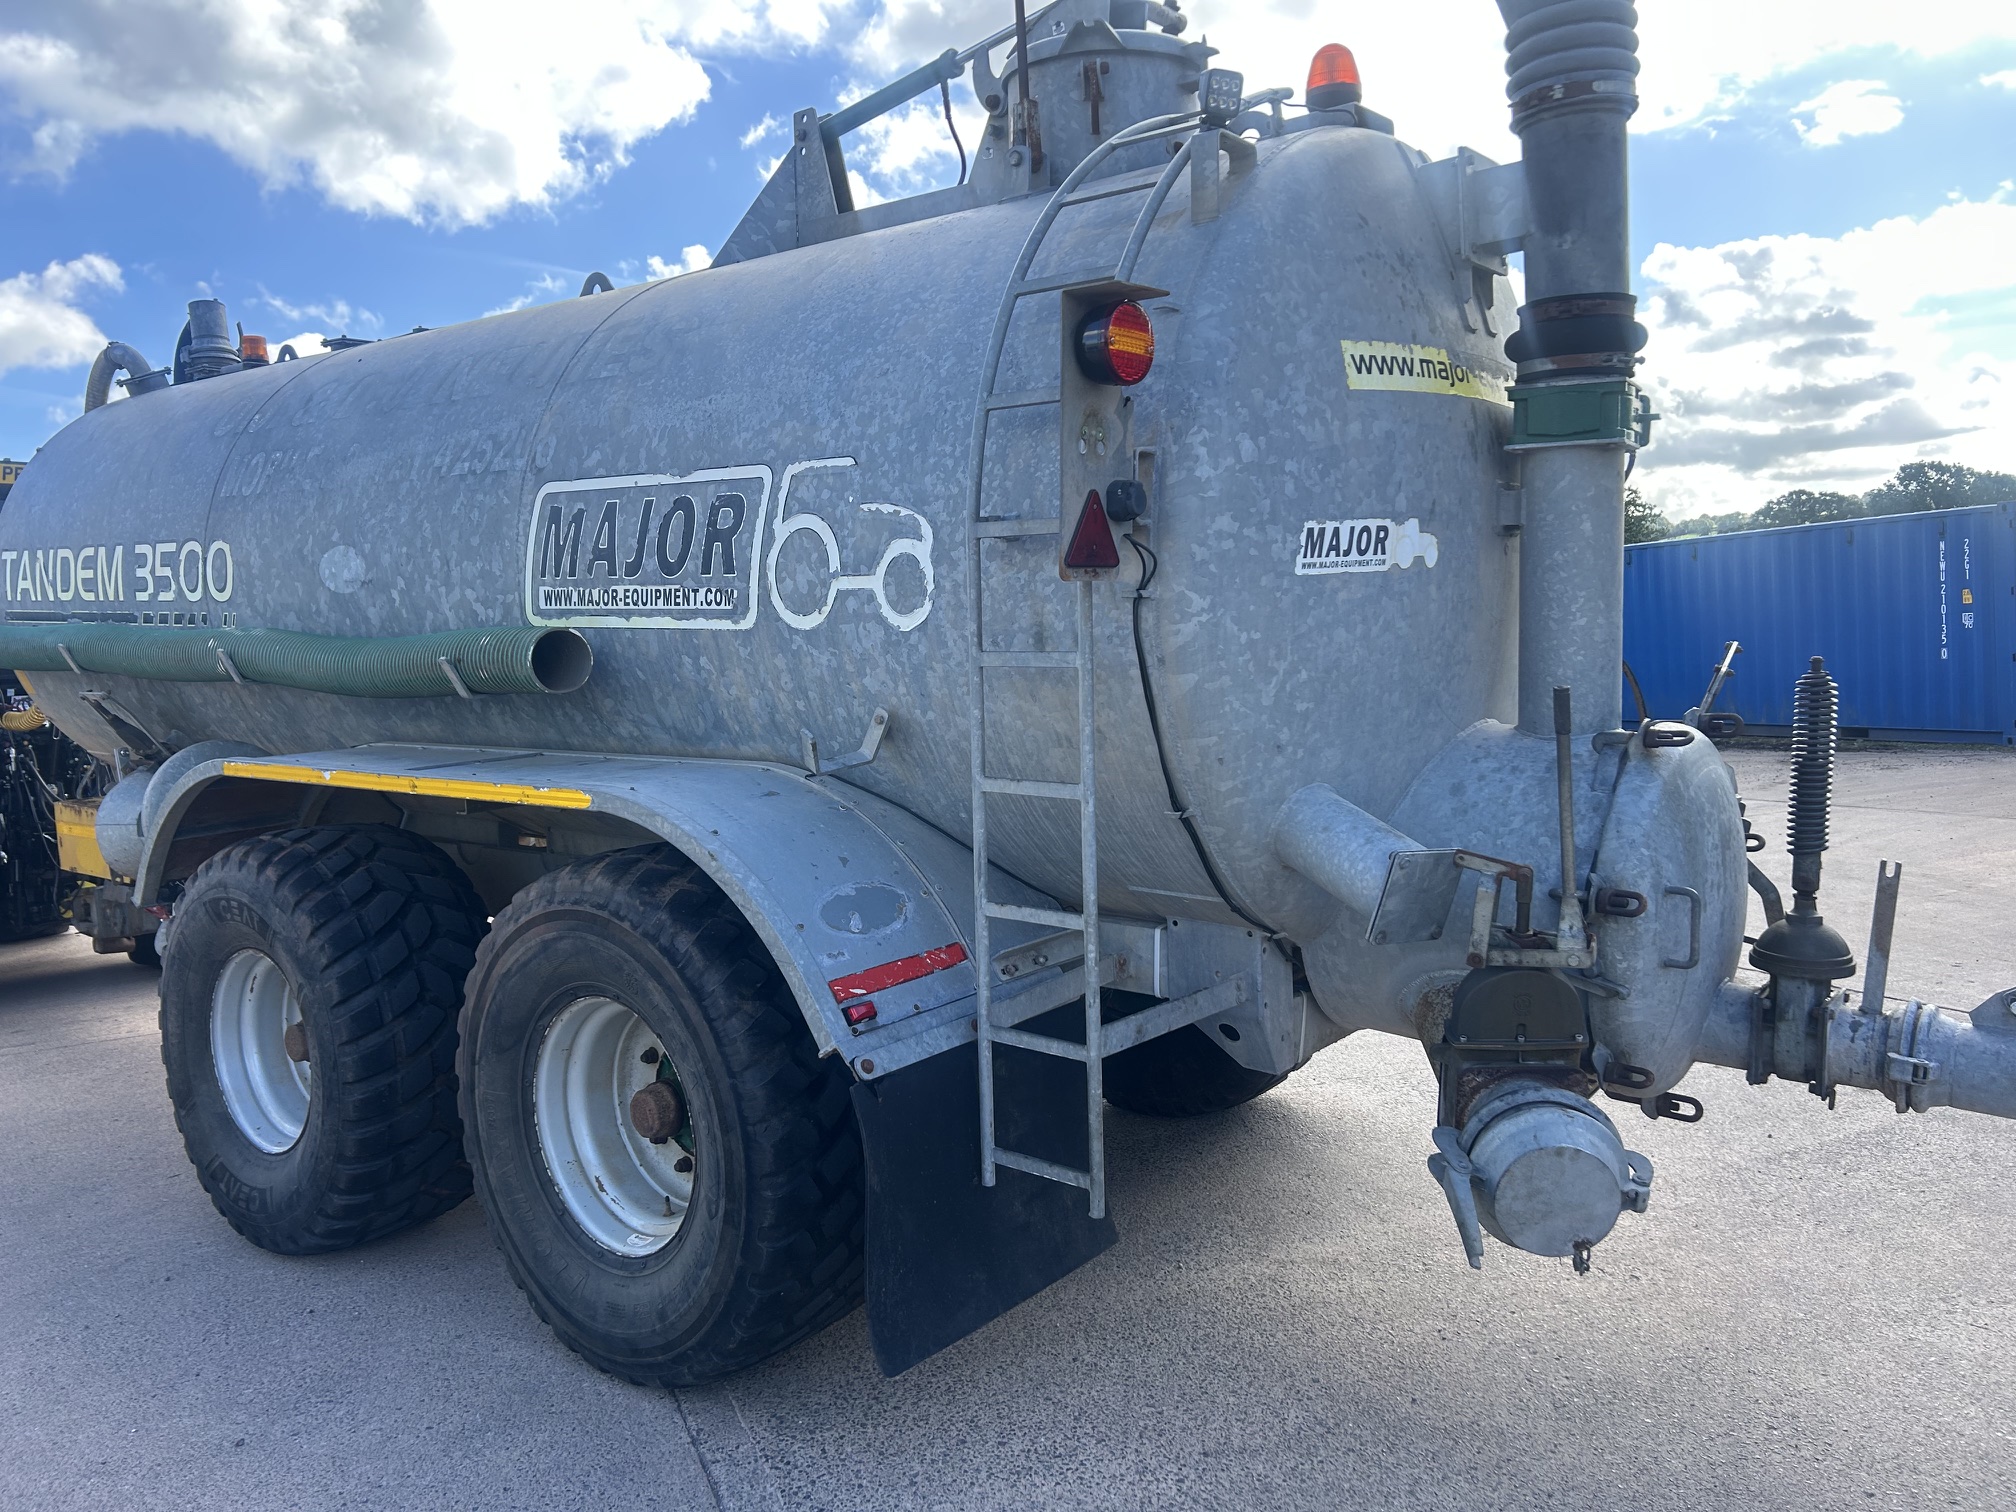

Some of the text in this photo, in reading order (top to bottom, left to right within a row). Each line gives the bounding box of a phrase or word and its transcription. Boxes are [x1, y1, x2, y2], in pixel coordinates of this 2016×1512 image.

[539, 492, 747, 579] MAJOR
[1302, 525, 1389, 559] MAJOR
[1, 540, 233, 602] TANDEM 3500
[1301, 559, 1387, 570] WWW.MAJOR-EQUIPMENT.COM
[543, 586, 736, 608] WWW.MAJOR-EQUIPMENT.COM
[219, 899, 260, 931] CEAT
